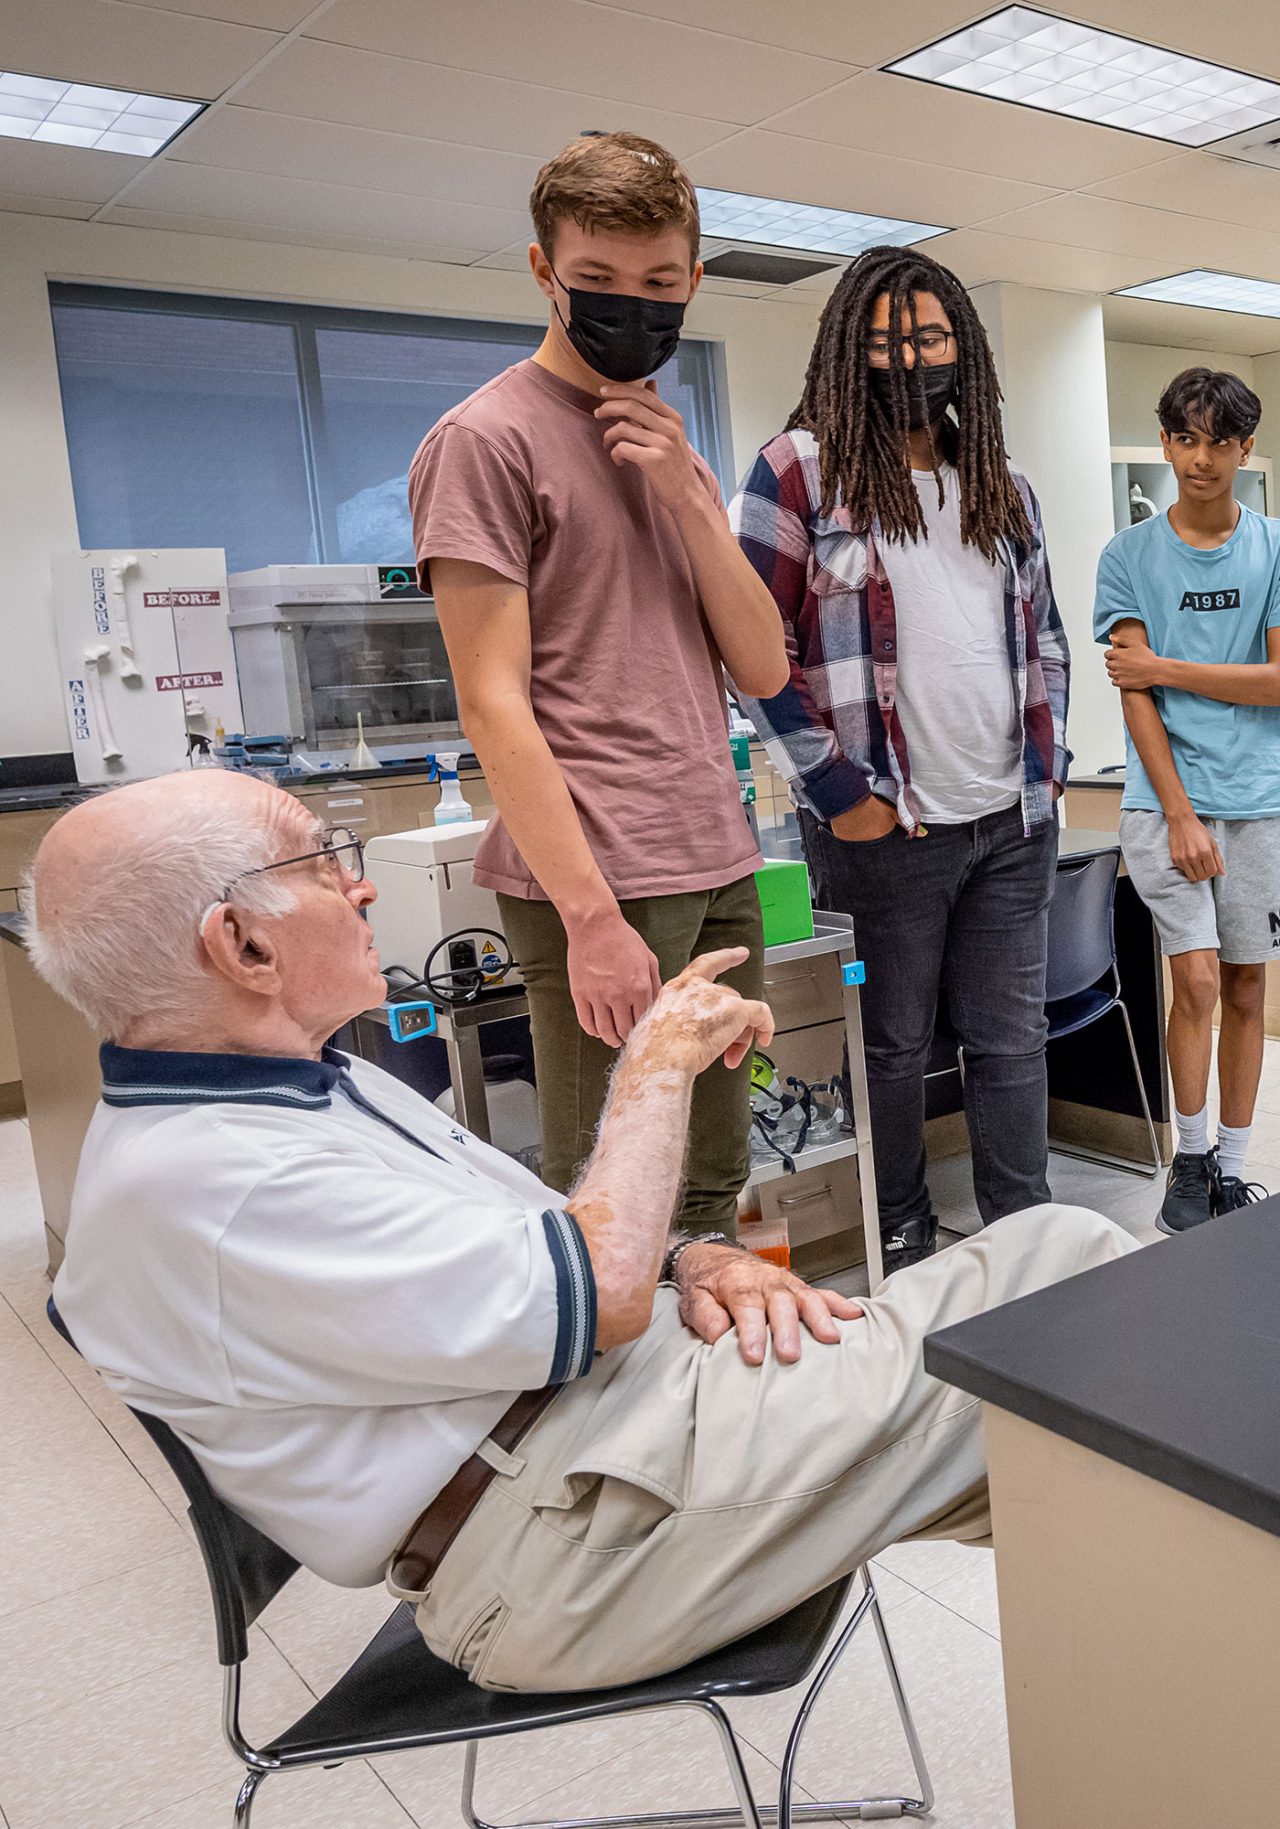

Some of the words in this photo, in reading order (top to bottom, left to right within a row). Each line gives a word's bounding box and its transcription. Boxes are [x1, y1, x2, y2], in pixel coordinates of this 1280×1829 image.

[91, 568, 110, 634] BEFORE
[1179, 589, 1240, 611] A1987
[69, 680, 89, 739] AFTER
